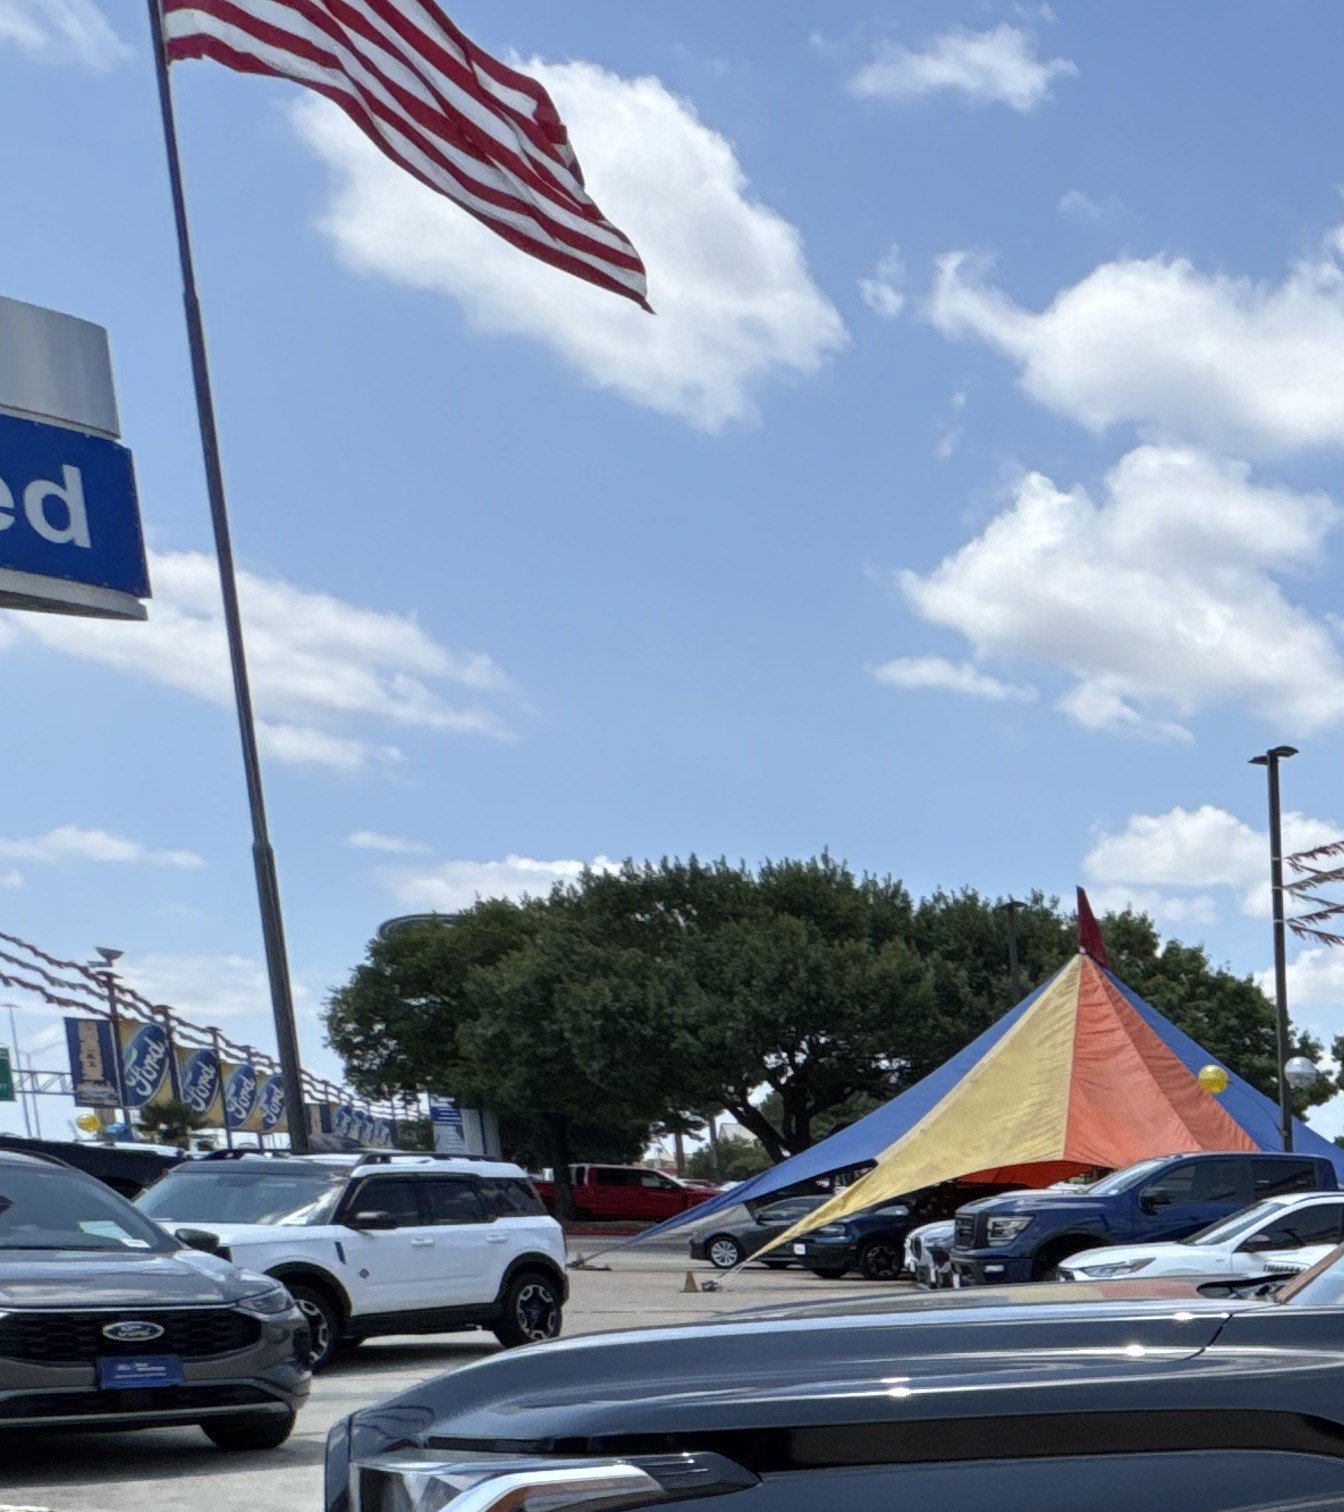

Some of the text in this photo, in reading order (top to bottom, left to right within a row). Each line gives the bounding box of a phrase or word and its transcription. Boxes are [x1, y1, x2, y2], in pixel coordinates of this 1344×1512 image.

[124, 1035, 165, 1096] Ford
[183, 1060, 216, 1112] Ford
[226, 1074, 255, 1119] Ford
